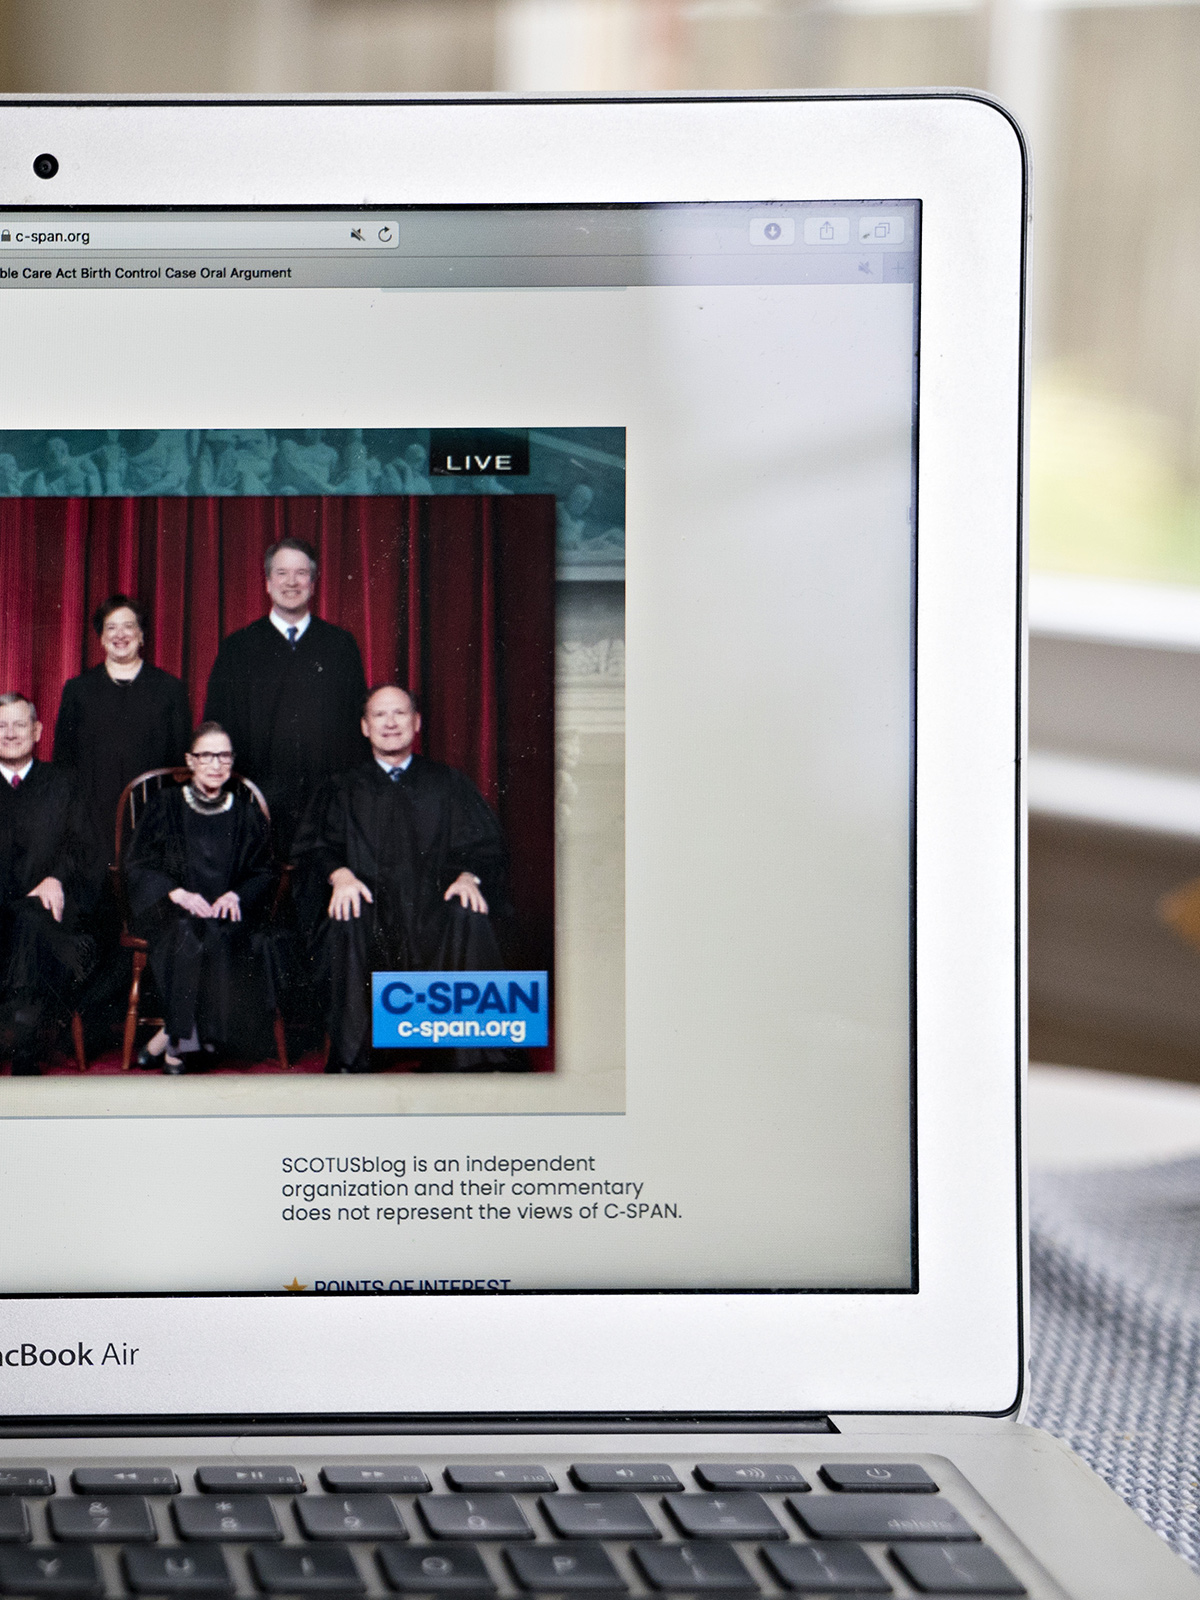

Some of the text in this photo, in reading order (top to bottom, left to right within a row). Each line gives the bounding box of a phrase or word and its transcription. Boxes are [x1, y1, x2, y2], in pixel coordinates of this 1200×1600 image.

[15, 228, 90, 245] c-span.org
[22, 267, 52, 279] Care
[55, 267, 77, 279] Act
[81, 267, 111, 279] Birth
[115, 267, 161, 279] Control
[165, 267, 197, 279] Case
[200, 267, 226, 279] Oral
[230, 267, 292, 282] Argument
[446, 455, 511, 470] LIVE
[398, 1020, 526, 1042] c-span.org
[282, 1155, 596, 1177] SCOTUSblog is an independent
[282, 1179, 644, 1202] organization and their commentary
[282, 1202, 682, 1225] does not represent the views of C-SPAN.
[101, 1342, 140, 1366] Air
[343, 1516, 361, 1530] 9
[37, 1557, 62, 1577] Y
